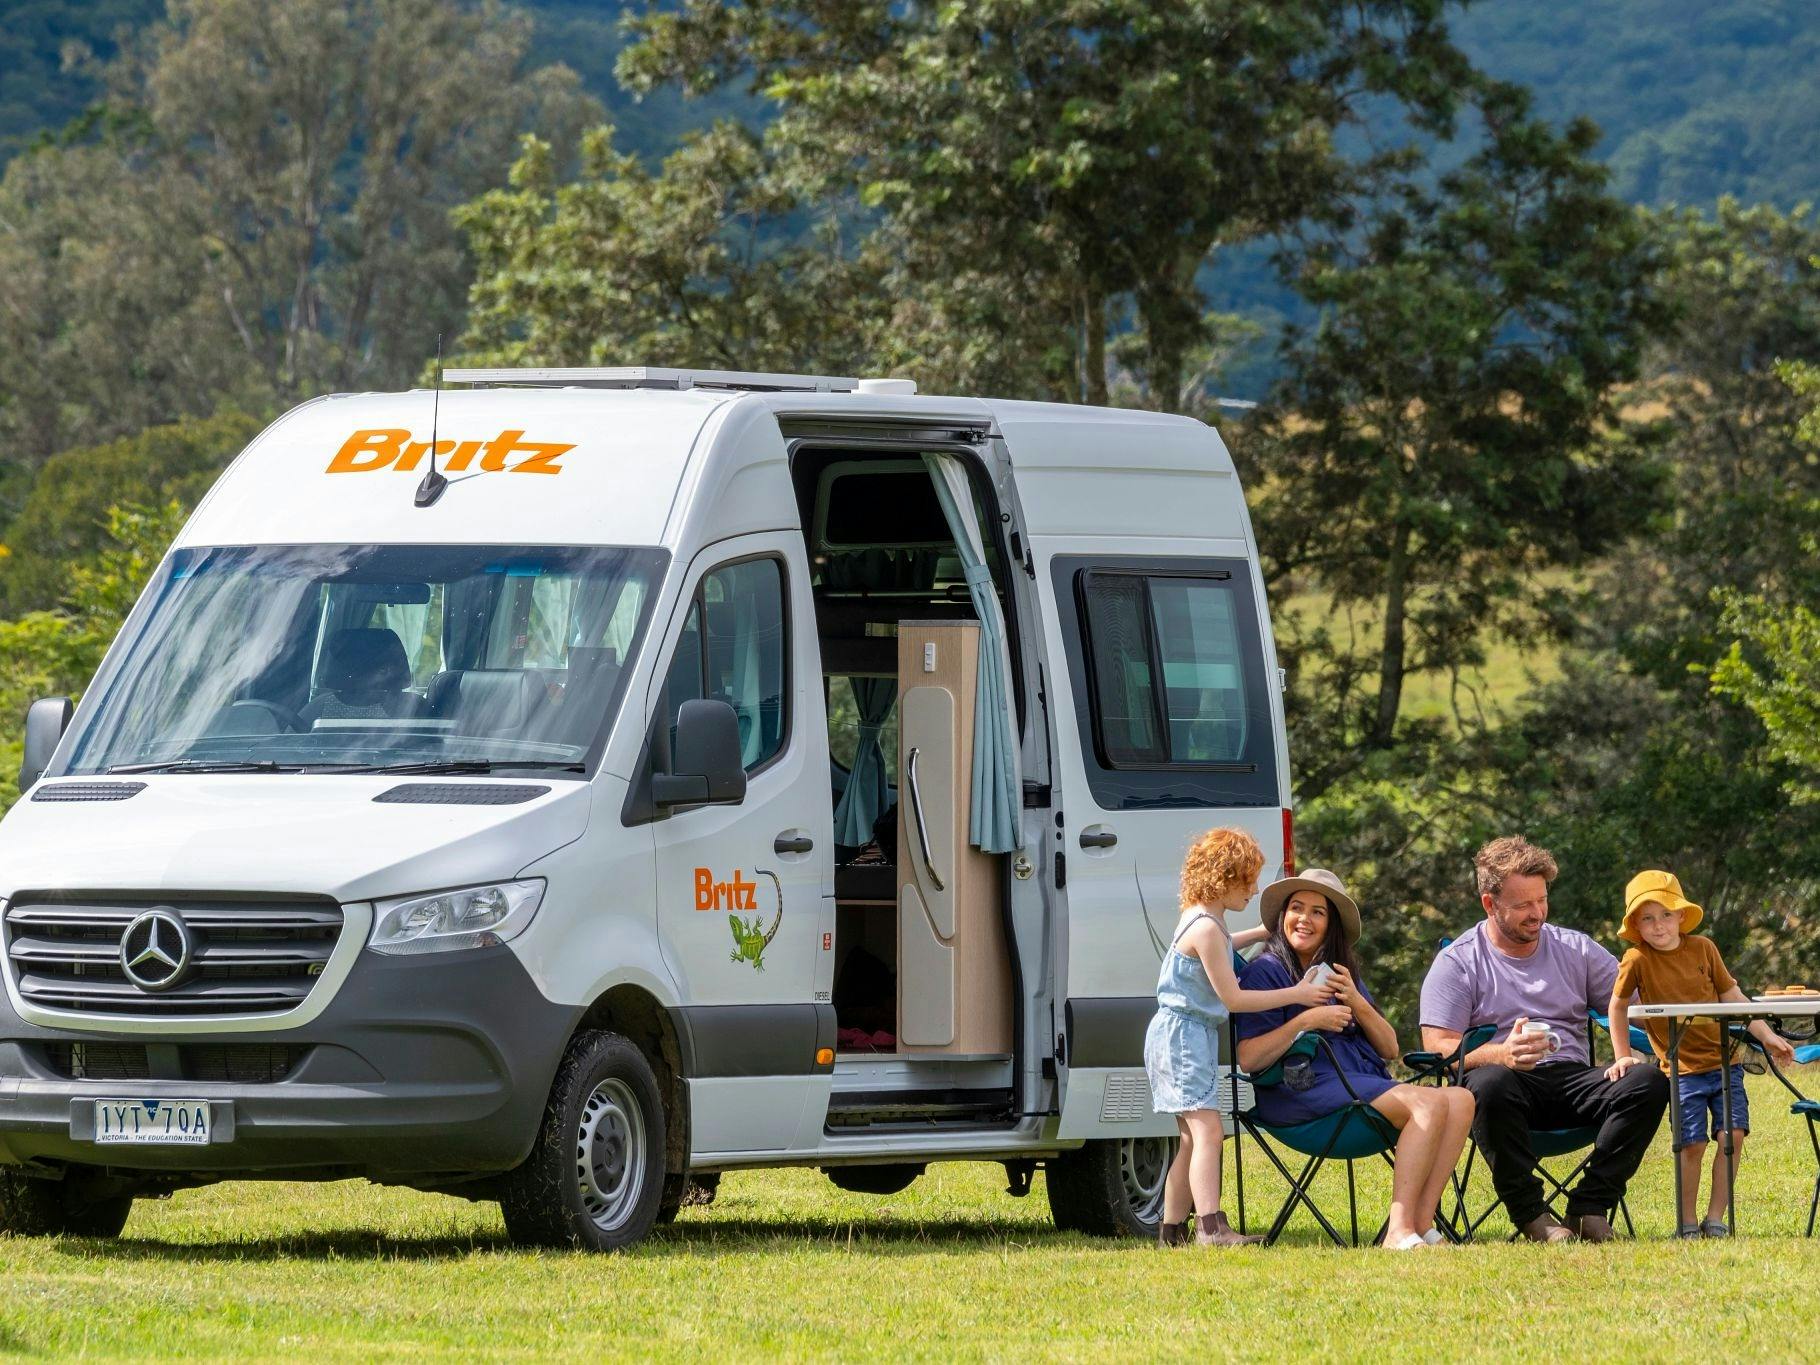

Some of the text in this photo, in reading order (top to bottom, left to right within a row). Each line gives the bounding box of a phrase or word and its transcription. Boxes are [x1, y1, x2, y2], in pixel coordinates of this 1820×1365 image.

[325, 429, 579, 474] Britz
[694, 867, 758, 911] Britz
[102, 1106, 206, 1134] 1YT 7QA
